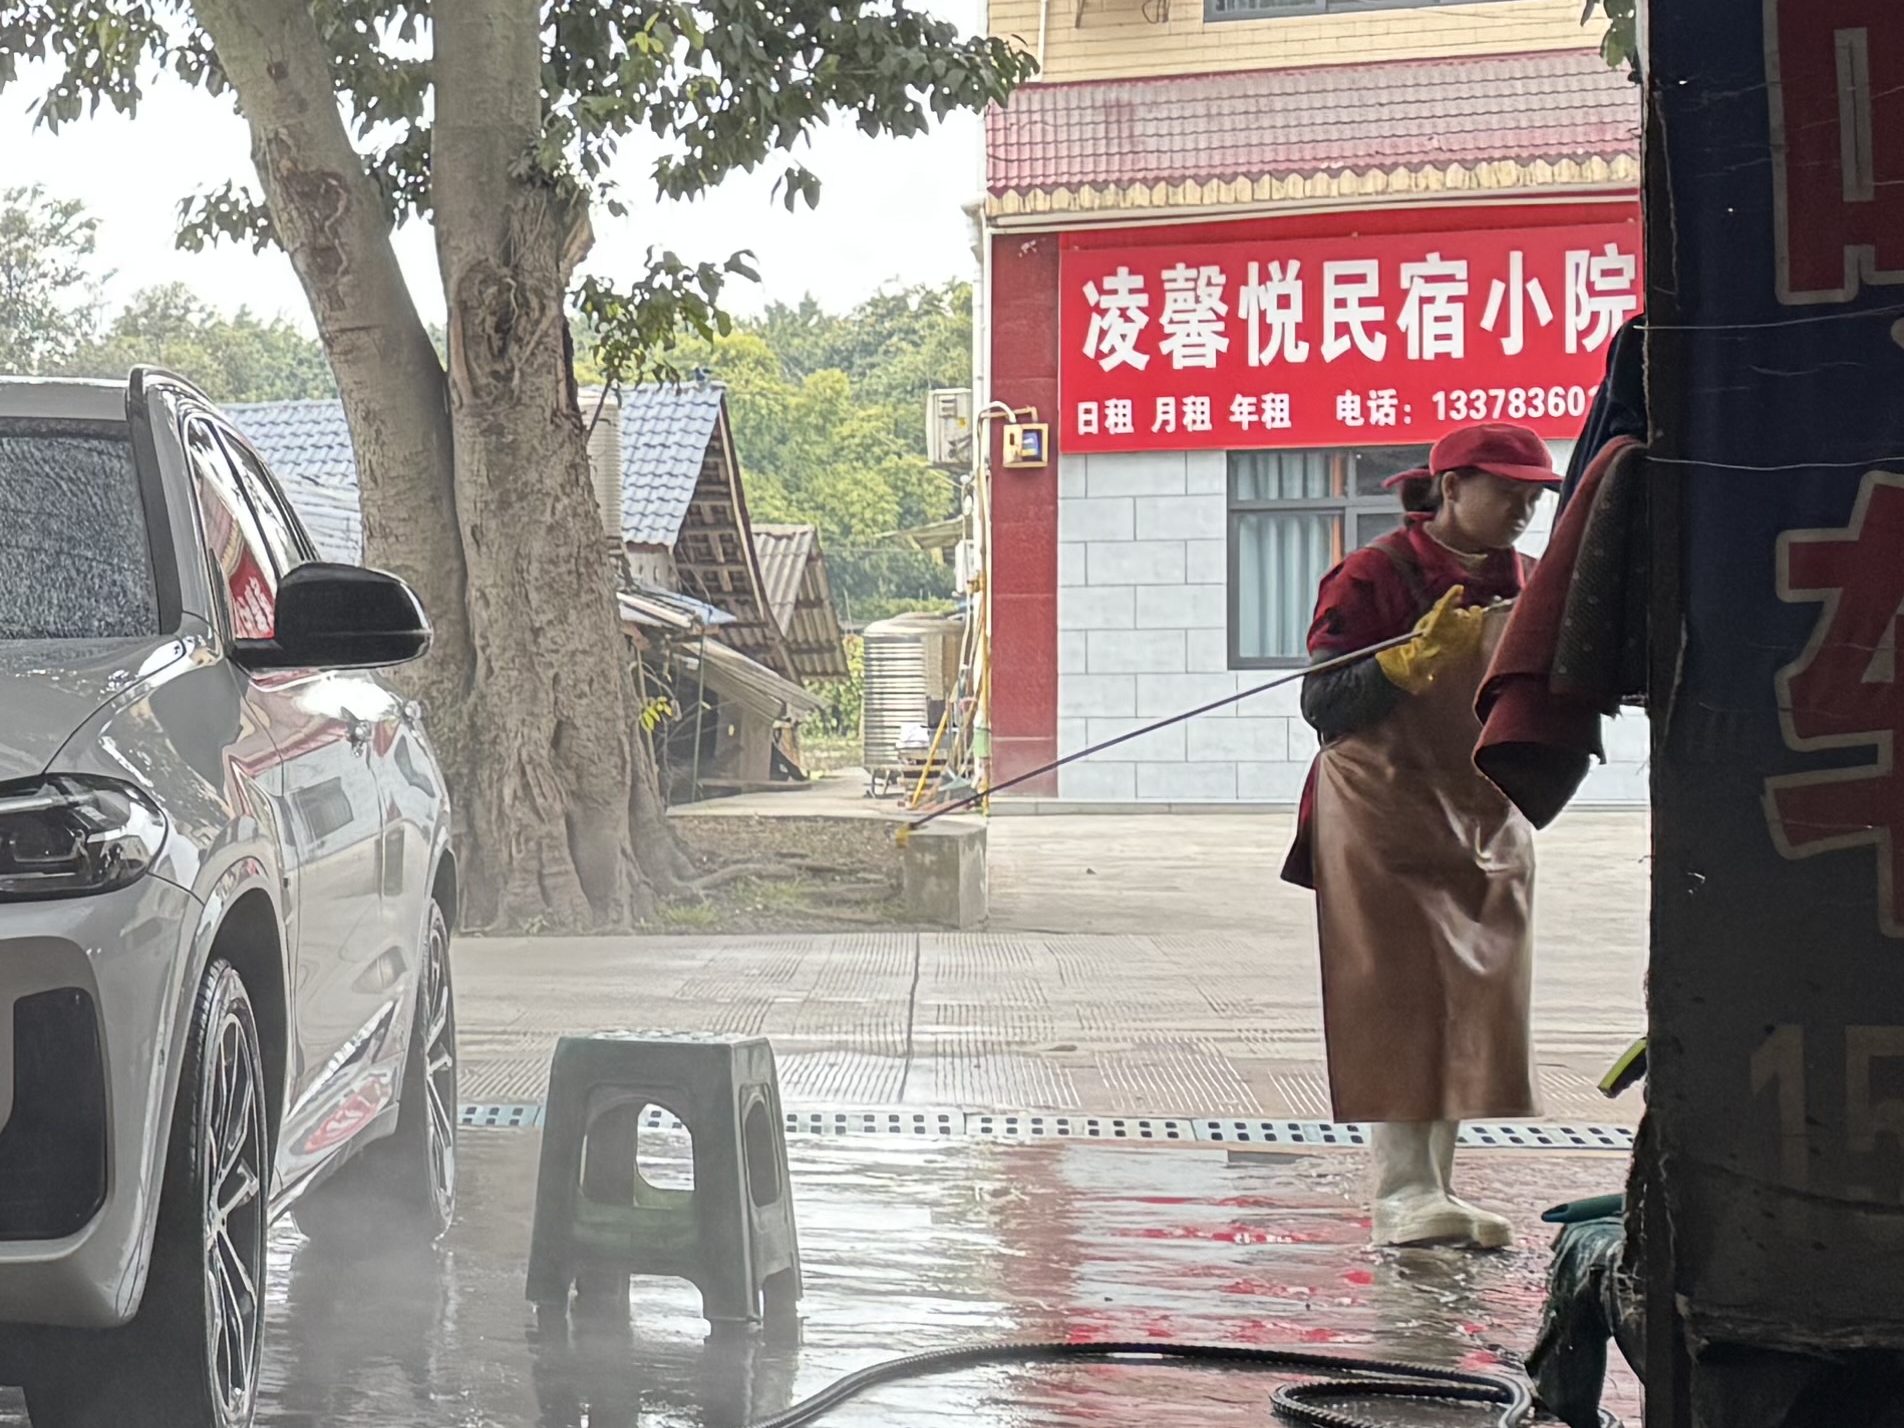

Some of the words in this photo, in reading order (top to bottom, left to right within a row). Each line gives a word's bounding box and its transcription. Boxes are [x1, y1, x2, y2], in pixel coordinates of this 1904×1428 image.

[1081, 242, 1638, 373] 凌馨悦民宿小院
[1076, 398, 1135, 435] 日租
[1151, 395, 1212, 433] 月租
[1228, 393, 1292, 430] 年租
